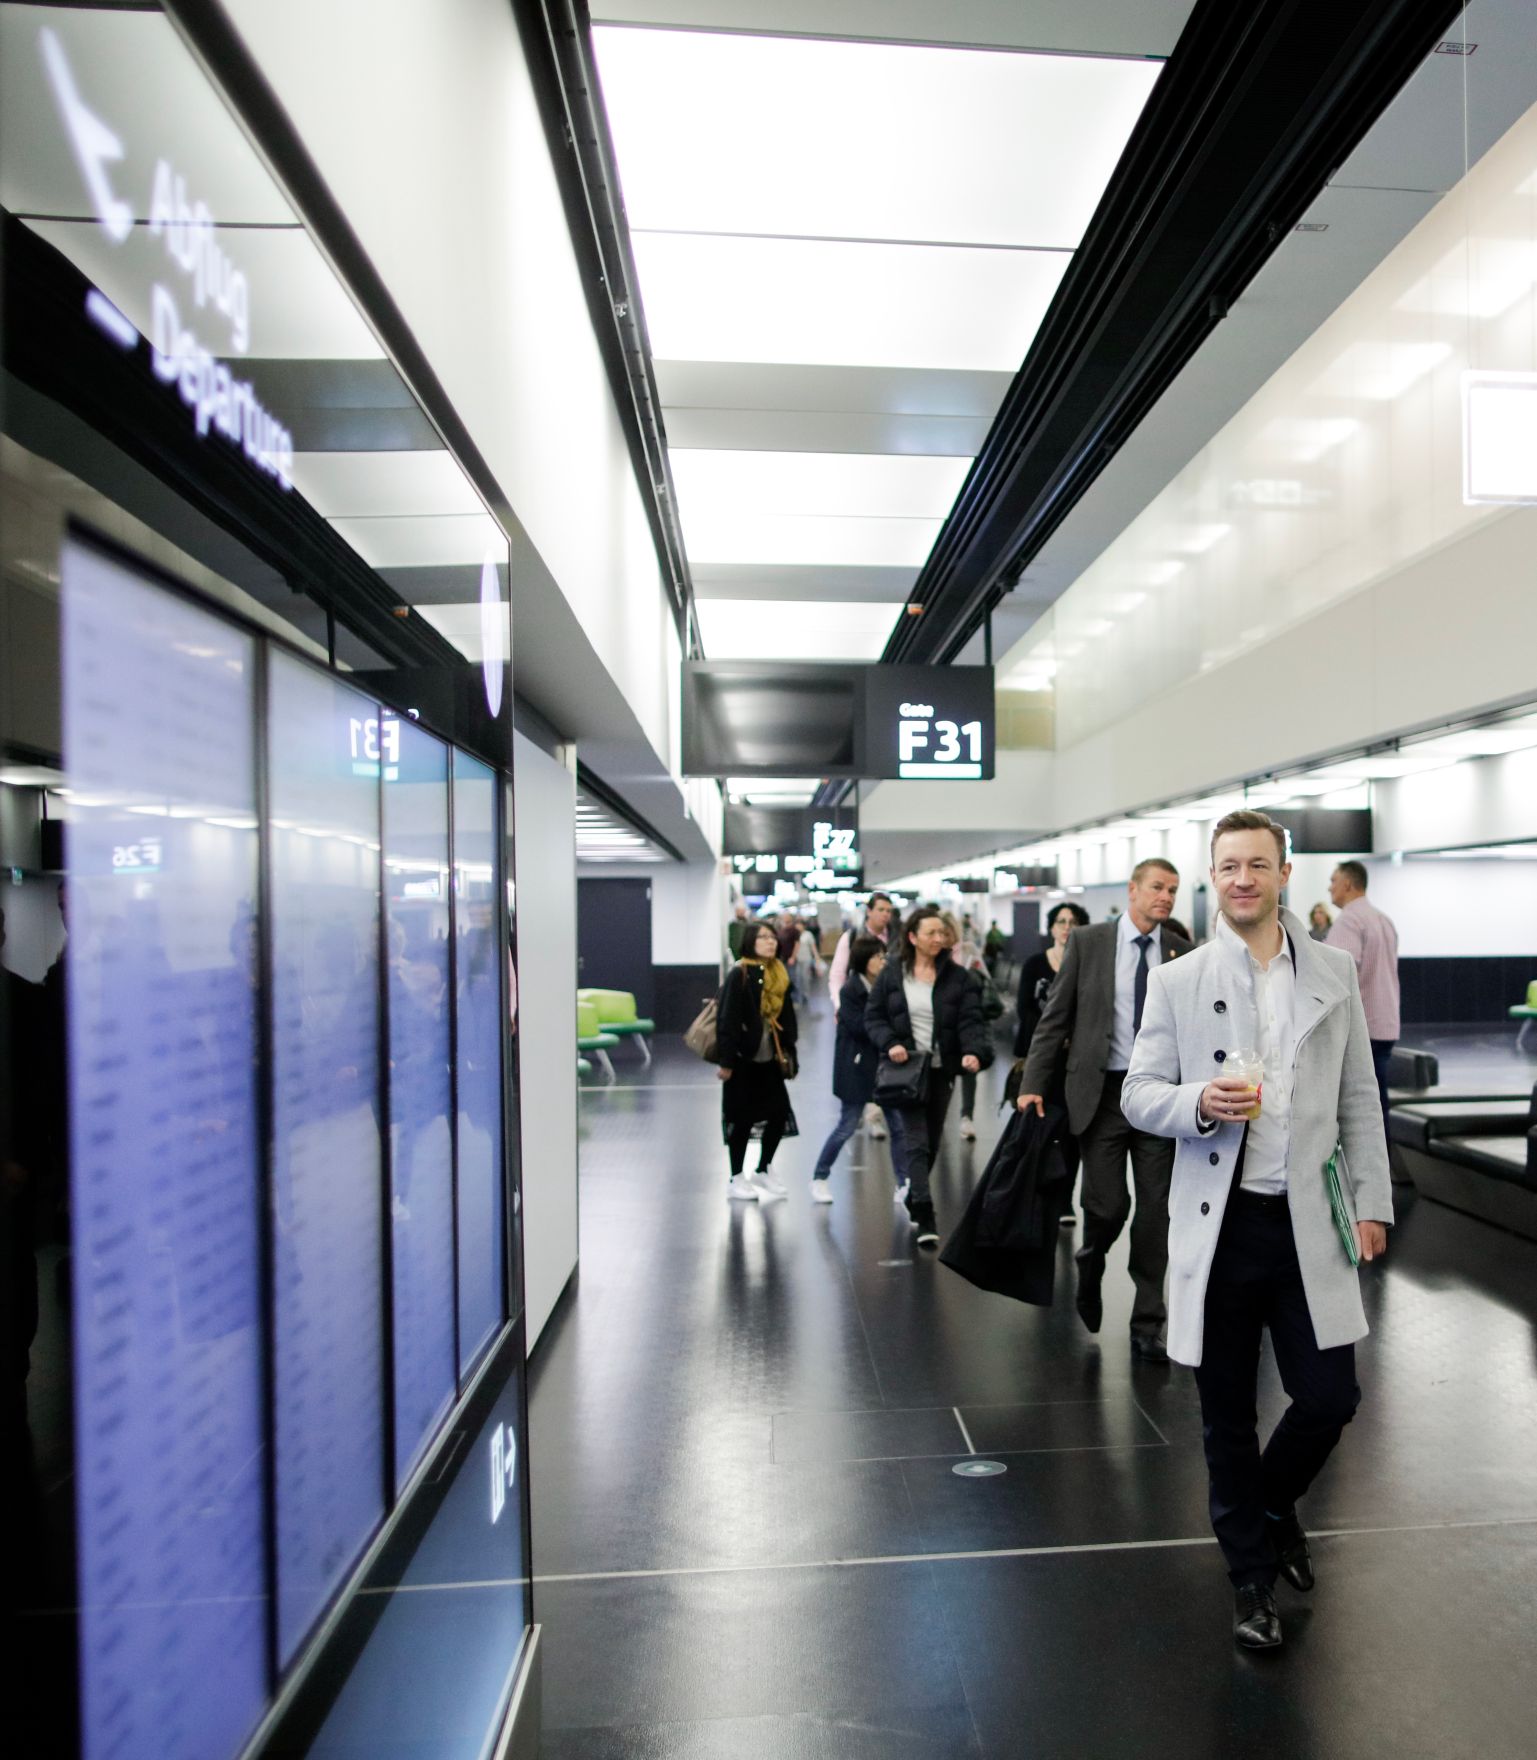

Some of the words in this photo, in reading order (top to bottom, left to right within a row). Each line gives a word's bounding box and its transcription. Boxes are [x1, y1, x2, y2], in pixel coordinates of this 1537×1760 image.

[151, 158, 249, 353] Abflug
[153, 283, 293, 489] Departure
[899, 703, 934, 717] Gate
[899, 720, 982, 762] F31
